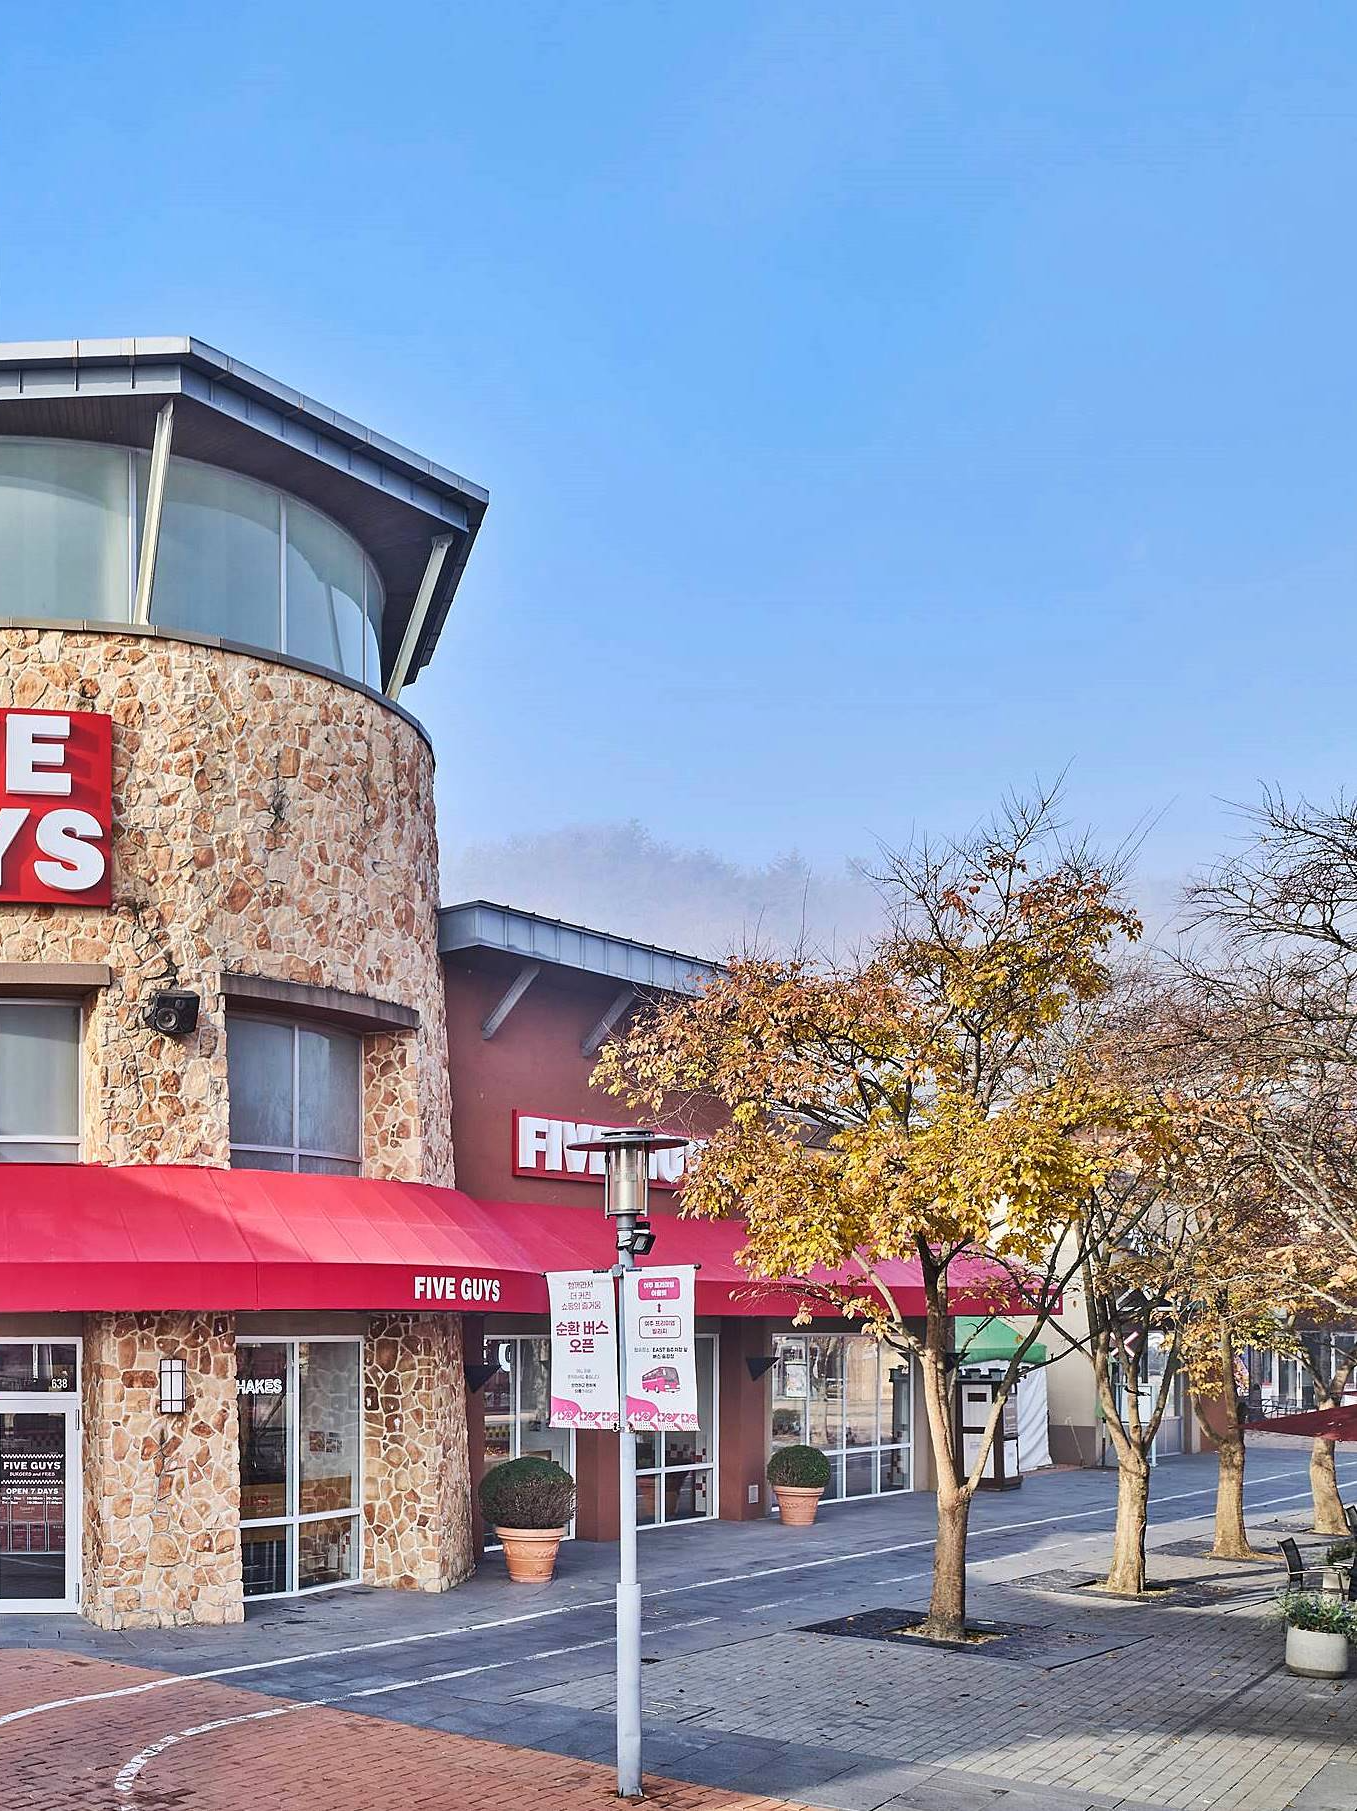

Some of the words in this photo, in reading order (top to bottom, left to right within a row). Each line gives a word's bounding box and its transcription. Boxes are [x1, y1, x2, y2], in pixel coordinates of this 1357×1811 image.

[414, 1276, 456, 1300] FIVE
[460, 1277, 501, 1302] GUYS
[570, 1291, 577, 1300] 더
[555, 1320, 580, 1336] 순환
[583, 1320, 609, 1336] 버스
[569, 1338, 595, 1354] 오픈
[51, 1378, 68, 1389] 638
[3, 1461, 28, 1470] FIVE
[31, 1461, 62, 1470] GUYS
